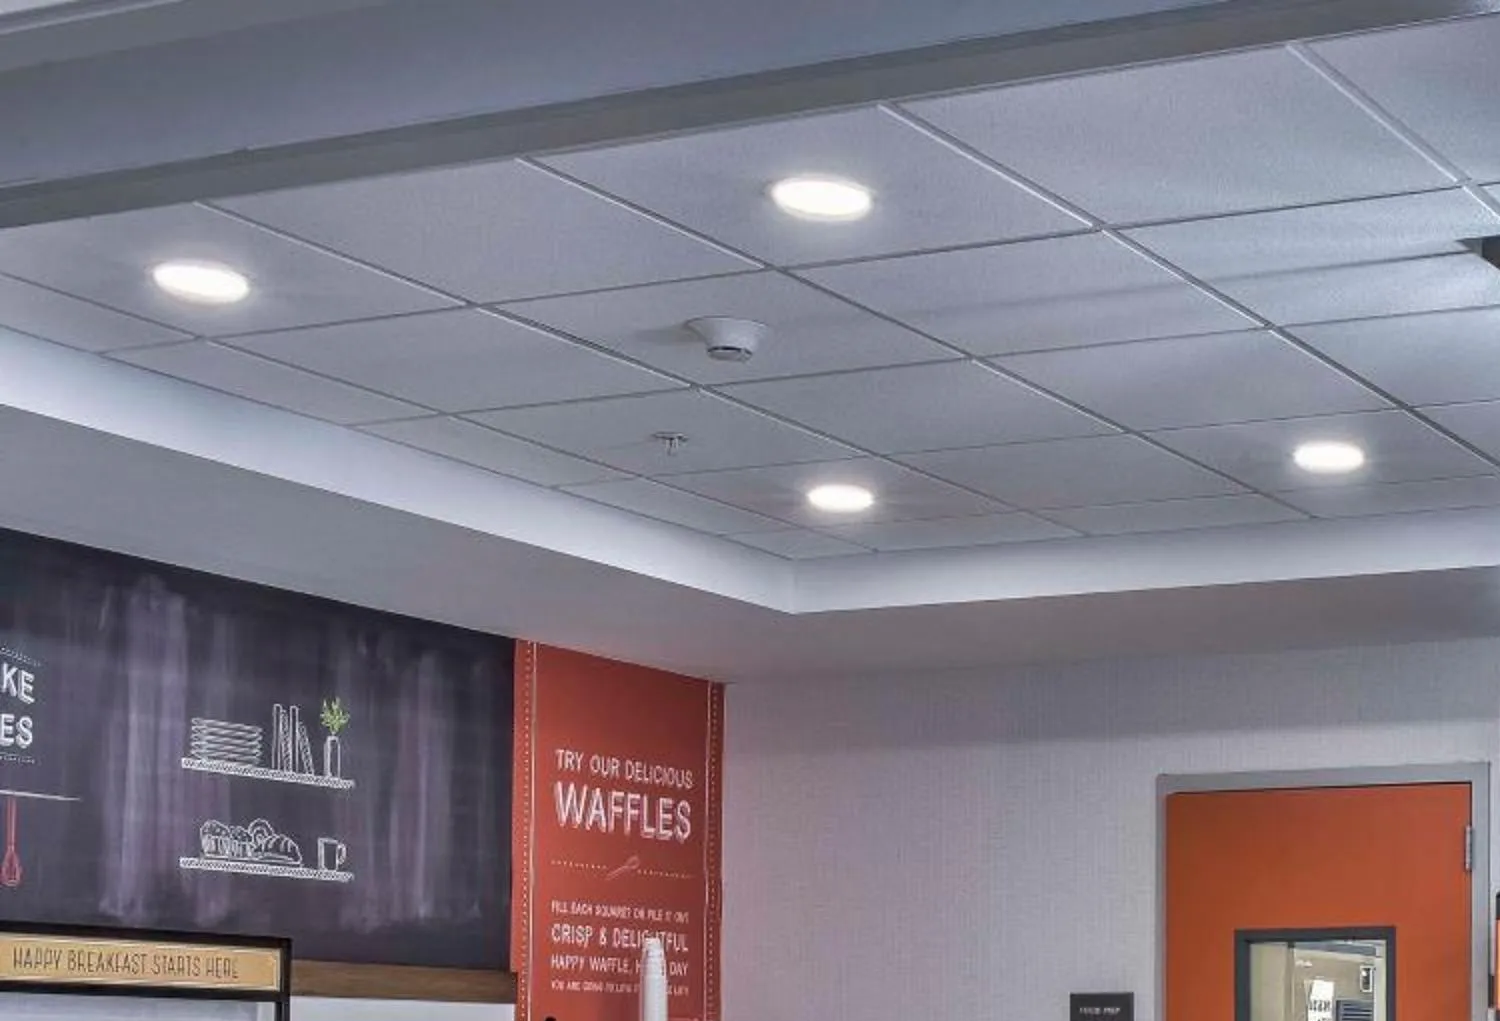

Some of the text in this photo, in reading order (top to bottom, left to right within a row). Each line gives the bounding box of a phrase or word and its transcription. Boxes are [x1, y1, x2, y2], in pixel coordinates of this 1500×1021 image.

[556, 749, 694, 789] TRY OUR DELICIOUS
[554, 781, 692, 843] WAFFLES
[551, 924, 593, 948] CRISP
[599, 927, 608, 946] &
[13, 947, 239, 979] HAPPY BREAKFAST STARTS HERE
[551, 954, 585, 972] HAPPY
[670, 961, 689, 977] DAY
